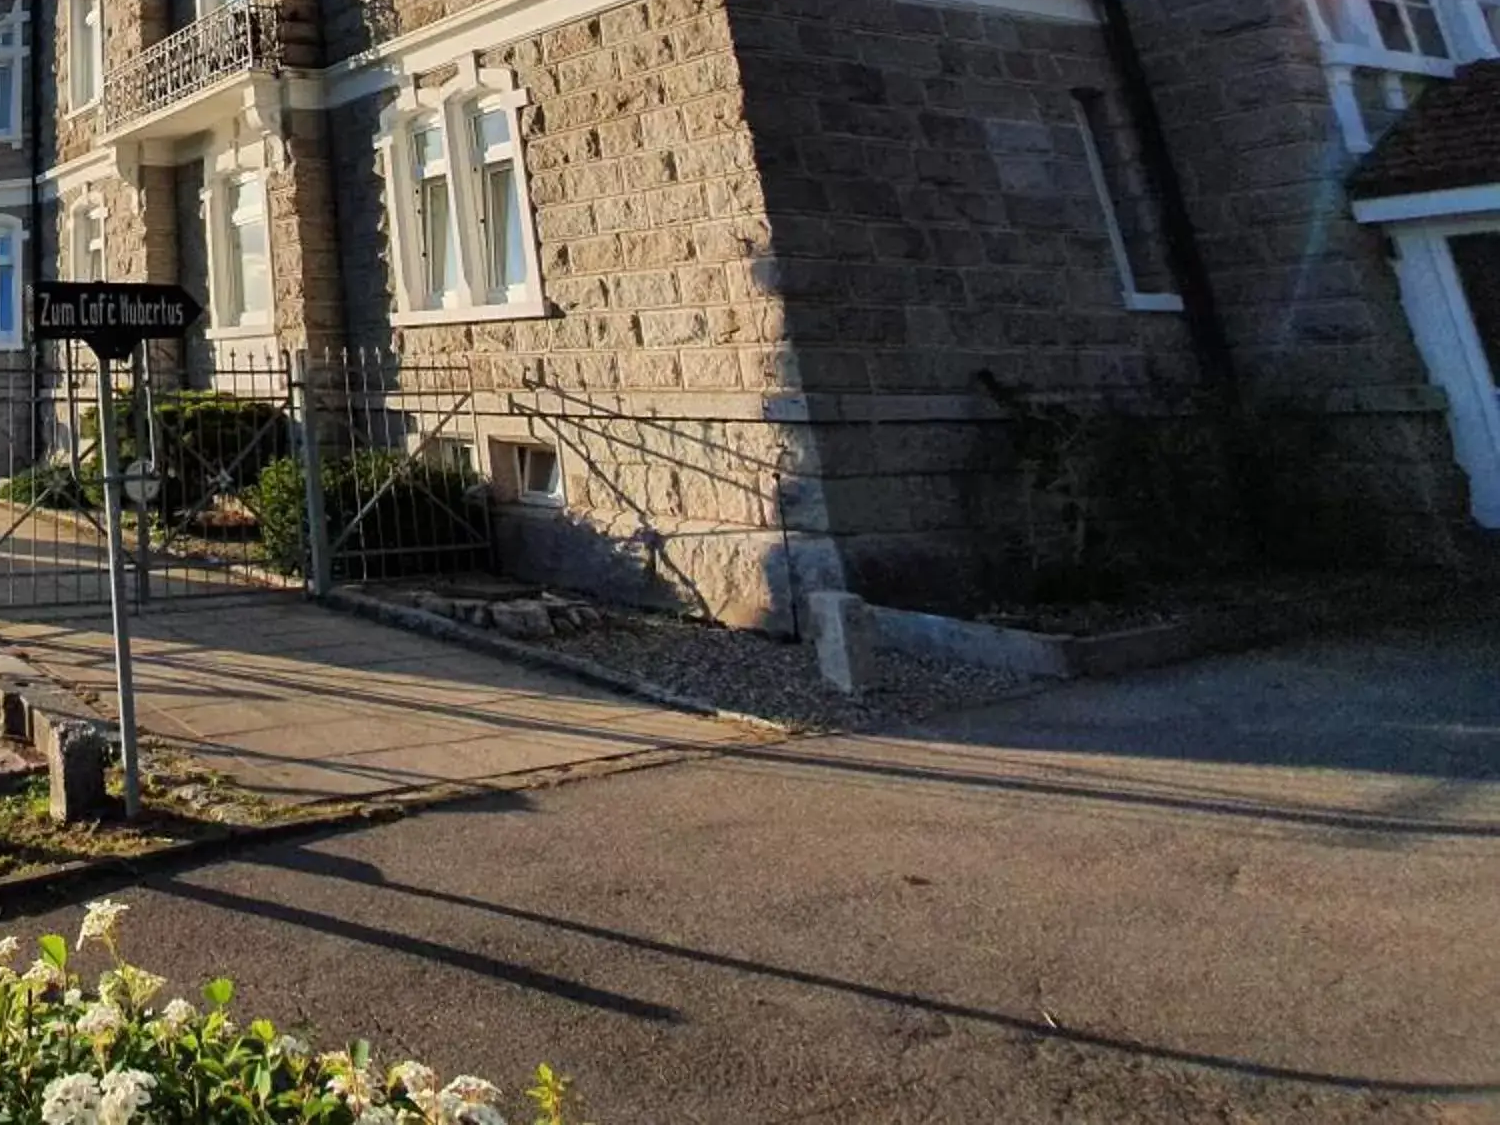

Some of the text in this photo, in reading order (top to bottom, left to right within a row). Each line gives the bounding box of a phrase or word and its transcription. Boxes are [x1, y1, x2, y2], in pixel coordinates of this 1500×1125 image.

[39, 291, 185, 327] Zum Café Hubertus
